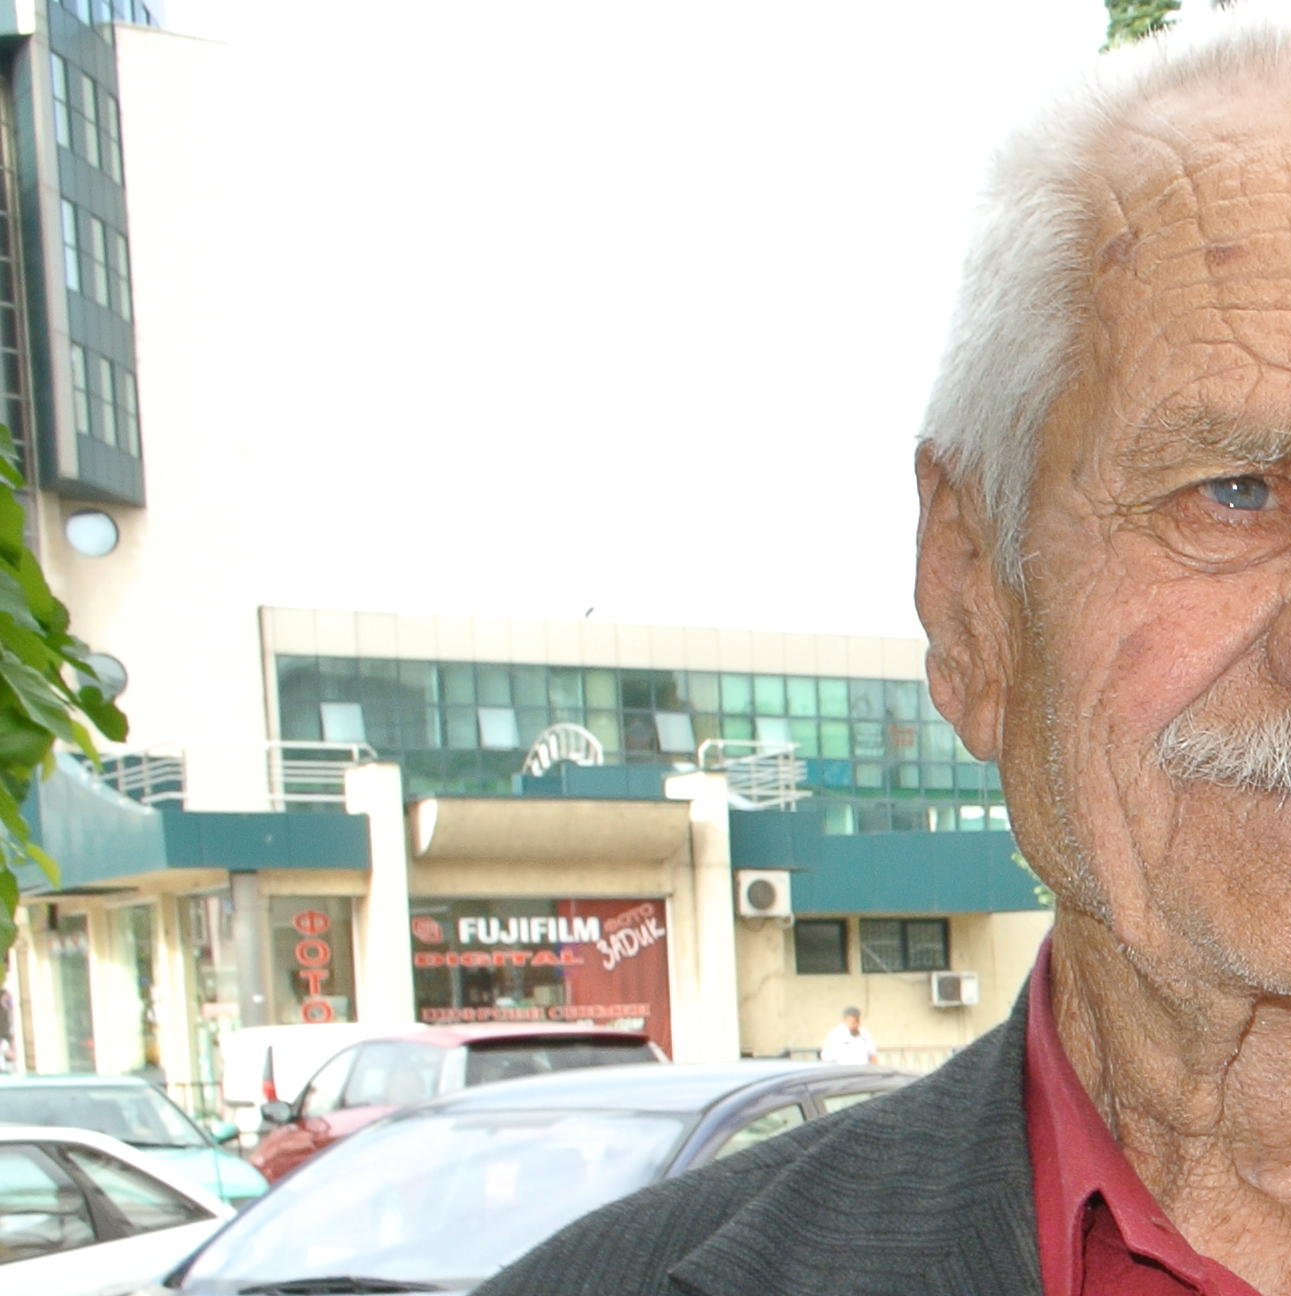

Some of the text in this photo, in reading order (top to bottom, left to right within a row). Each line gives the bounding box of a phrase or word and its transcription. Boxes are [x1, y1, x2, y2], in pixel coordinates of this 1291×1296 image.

[458, 916, 600, 944] FUJIFILM
[292, 908, 334, 1024] ФОТО
[415, 949, 584, 967] DIGITAL
